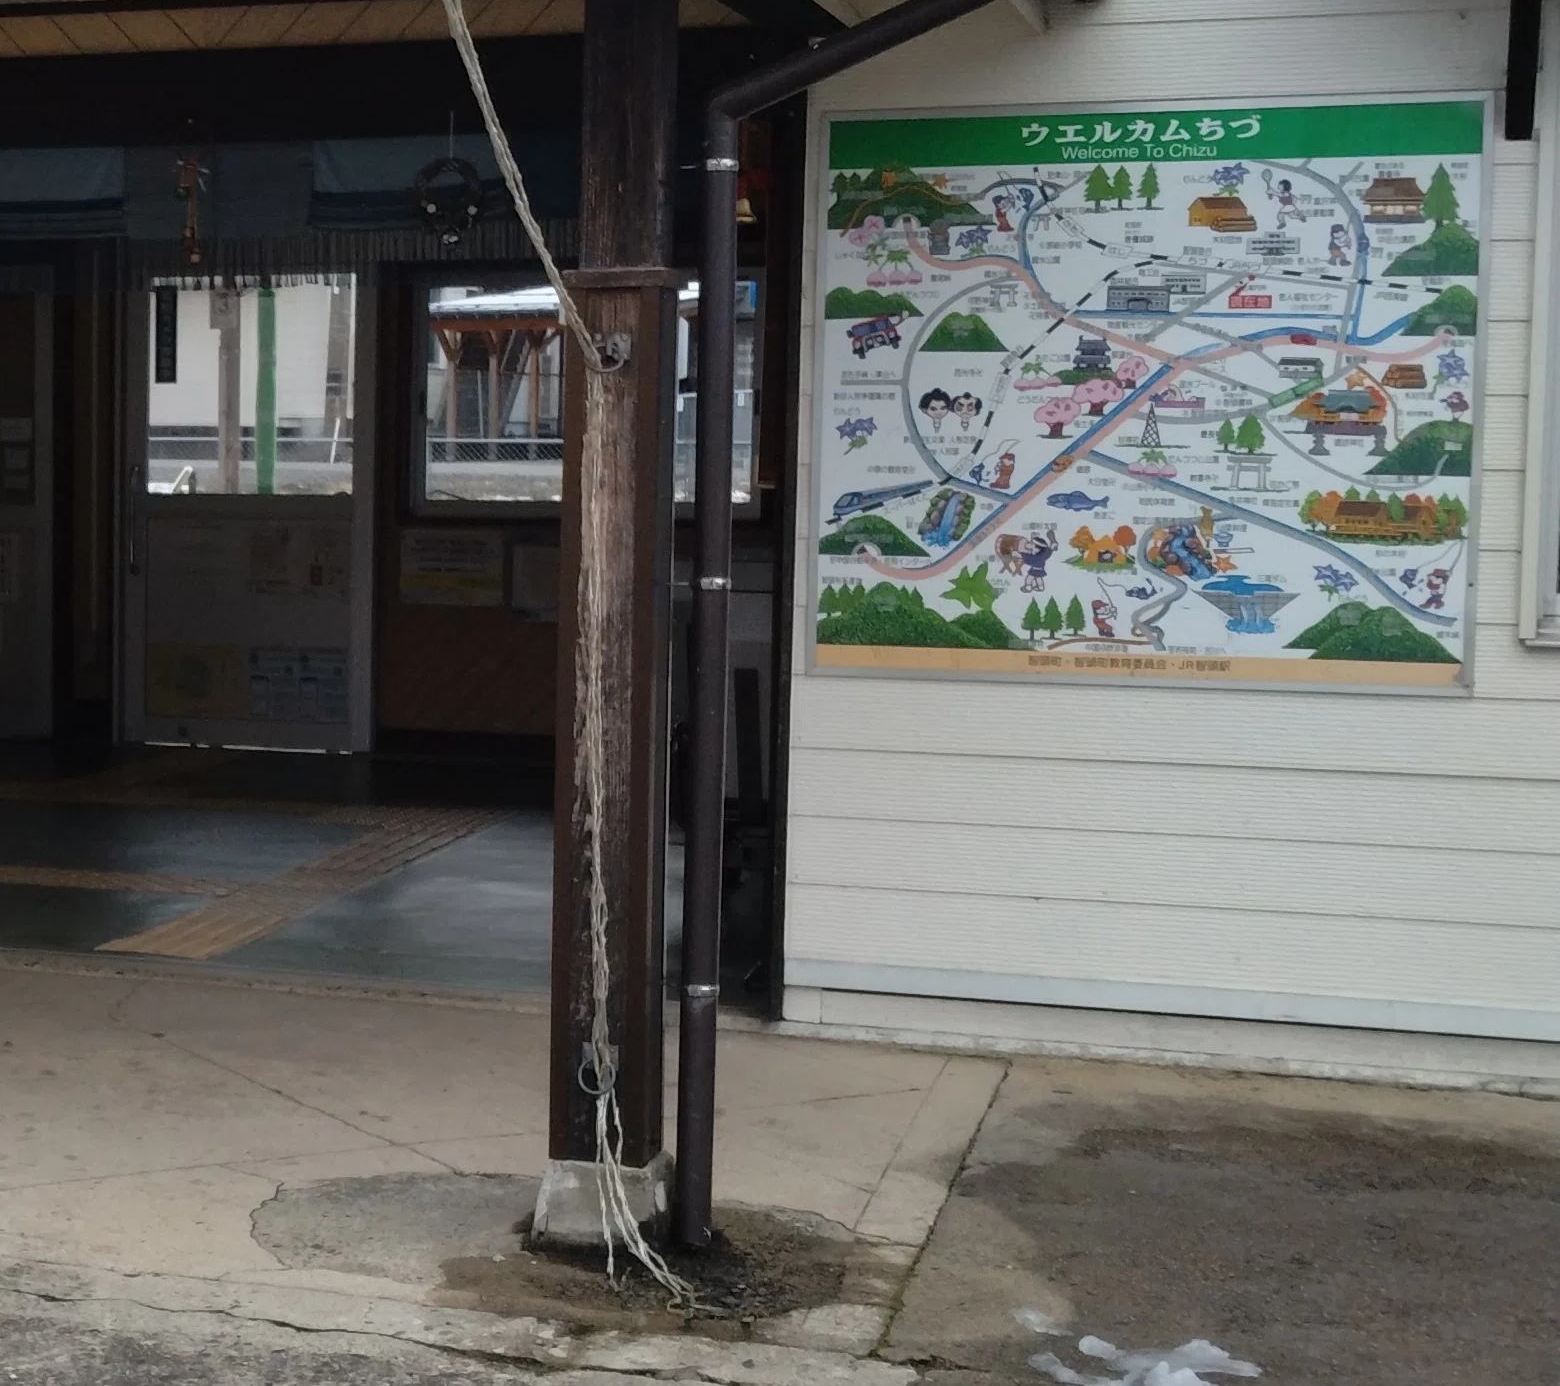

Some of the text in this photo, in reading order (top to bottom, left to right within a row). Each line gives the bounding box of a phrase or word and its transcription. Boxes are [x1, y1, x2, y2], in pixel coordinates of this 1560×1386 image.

[1020, 114, 1262, 147] ウエルカムちづ
[1061, 142, 1218, 161] Welcome To Chizu
